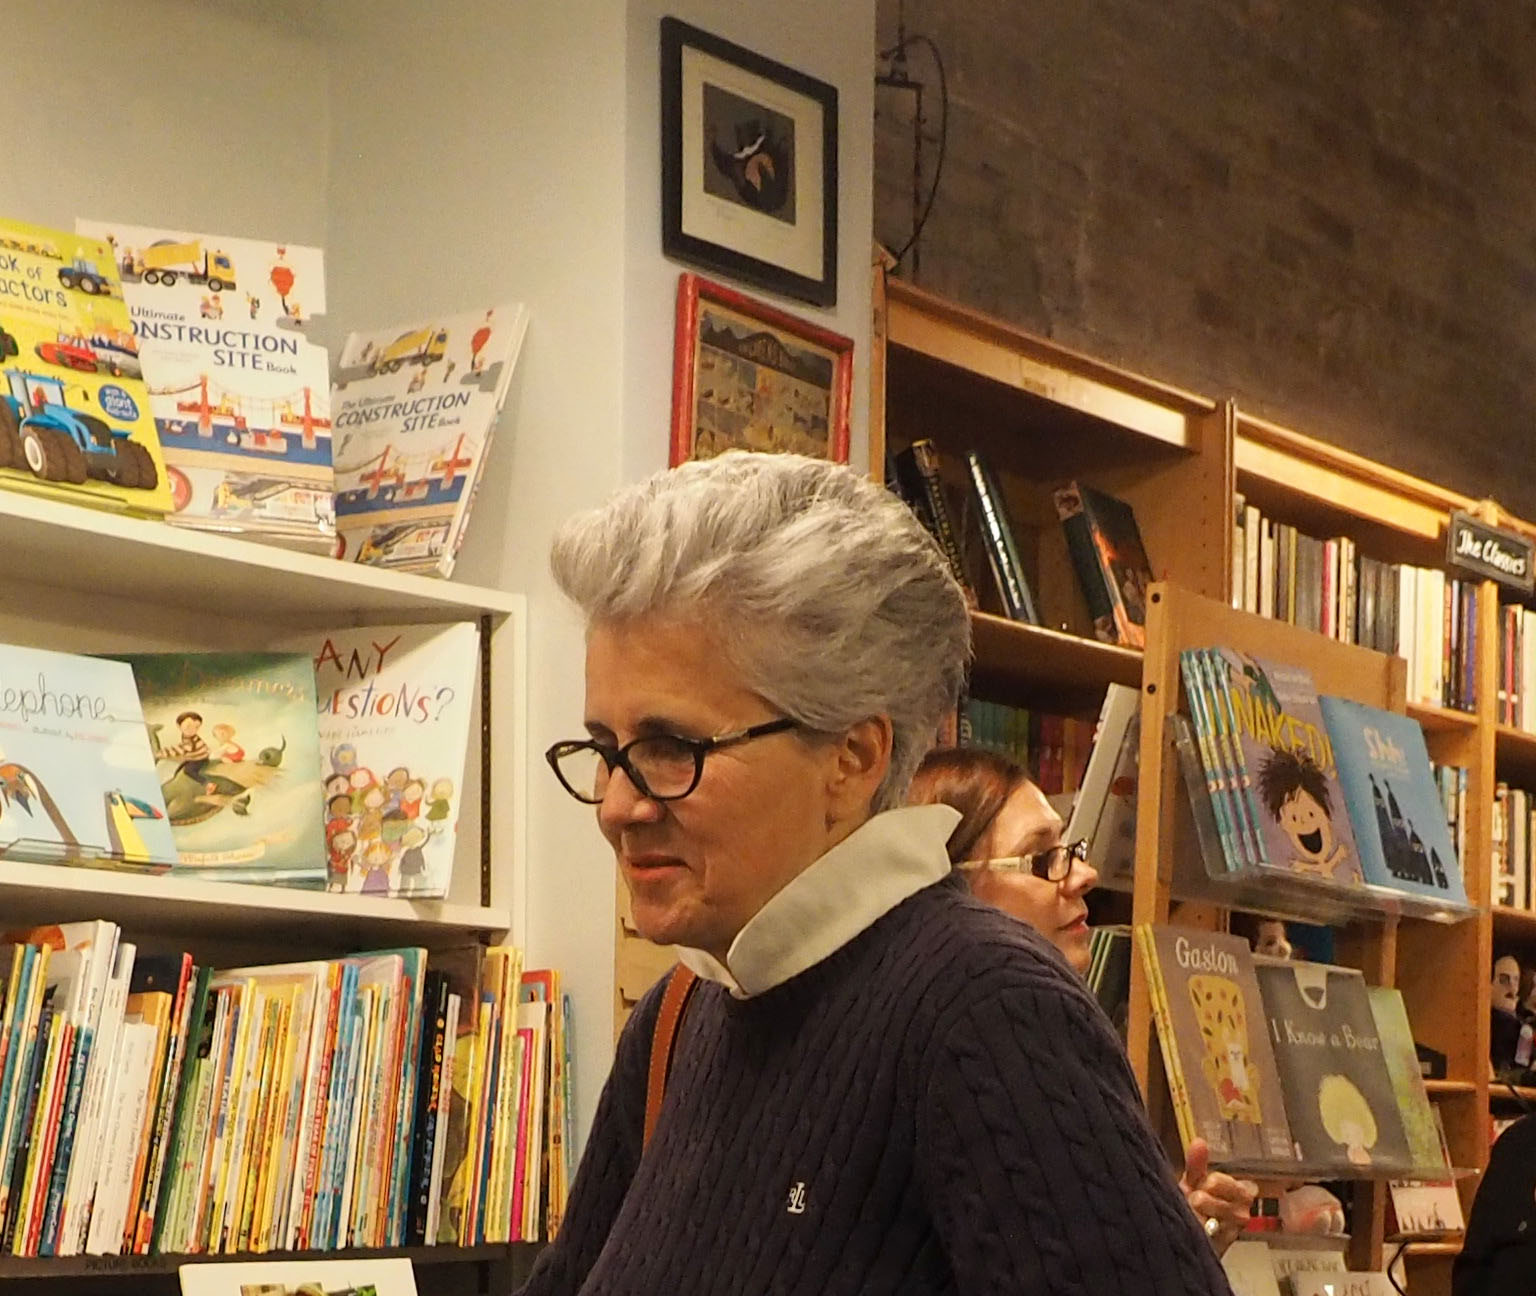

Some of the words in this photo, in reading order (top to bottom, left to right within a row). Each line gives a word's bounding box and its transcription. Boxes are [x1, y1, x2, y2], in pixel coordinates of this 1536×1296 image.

[26, 265, 42, 280] of
[130, 306, 186, 321] Ultimate
[213, 349, 263, 371] SITE
[266, 361, 297, 376] Book
[336, 392, 471, 428] CONSTRUCTION
[399, 414, 437, 433] SITE
[1456, 529, 1482, 559] The
[1482, 538, 1526, 576] Classics
[316, 635, 402, 680] ANY
[316, 684, 456, 723] UESTIONS?
[1175, 936, 1239, 975] Gaston
[1272, 1019, 1280, 1043] I
[1287, 1019, 1327, 1045] Know
[1331, 1038, 1339, 1047] a
[1342, 1025, 1379, 1051] Bear
[136, 1088, 145, 1103] The
[132, 1106, 142, 1124] Very
